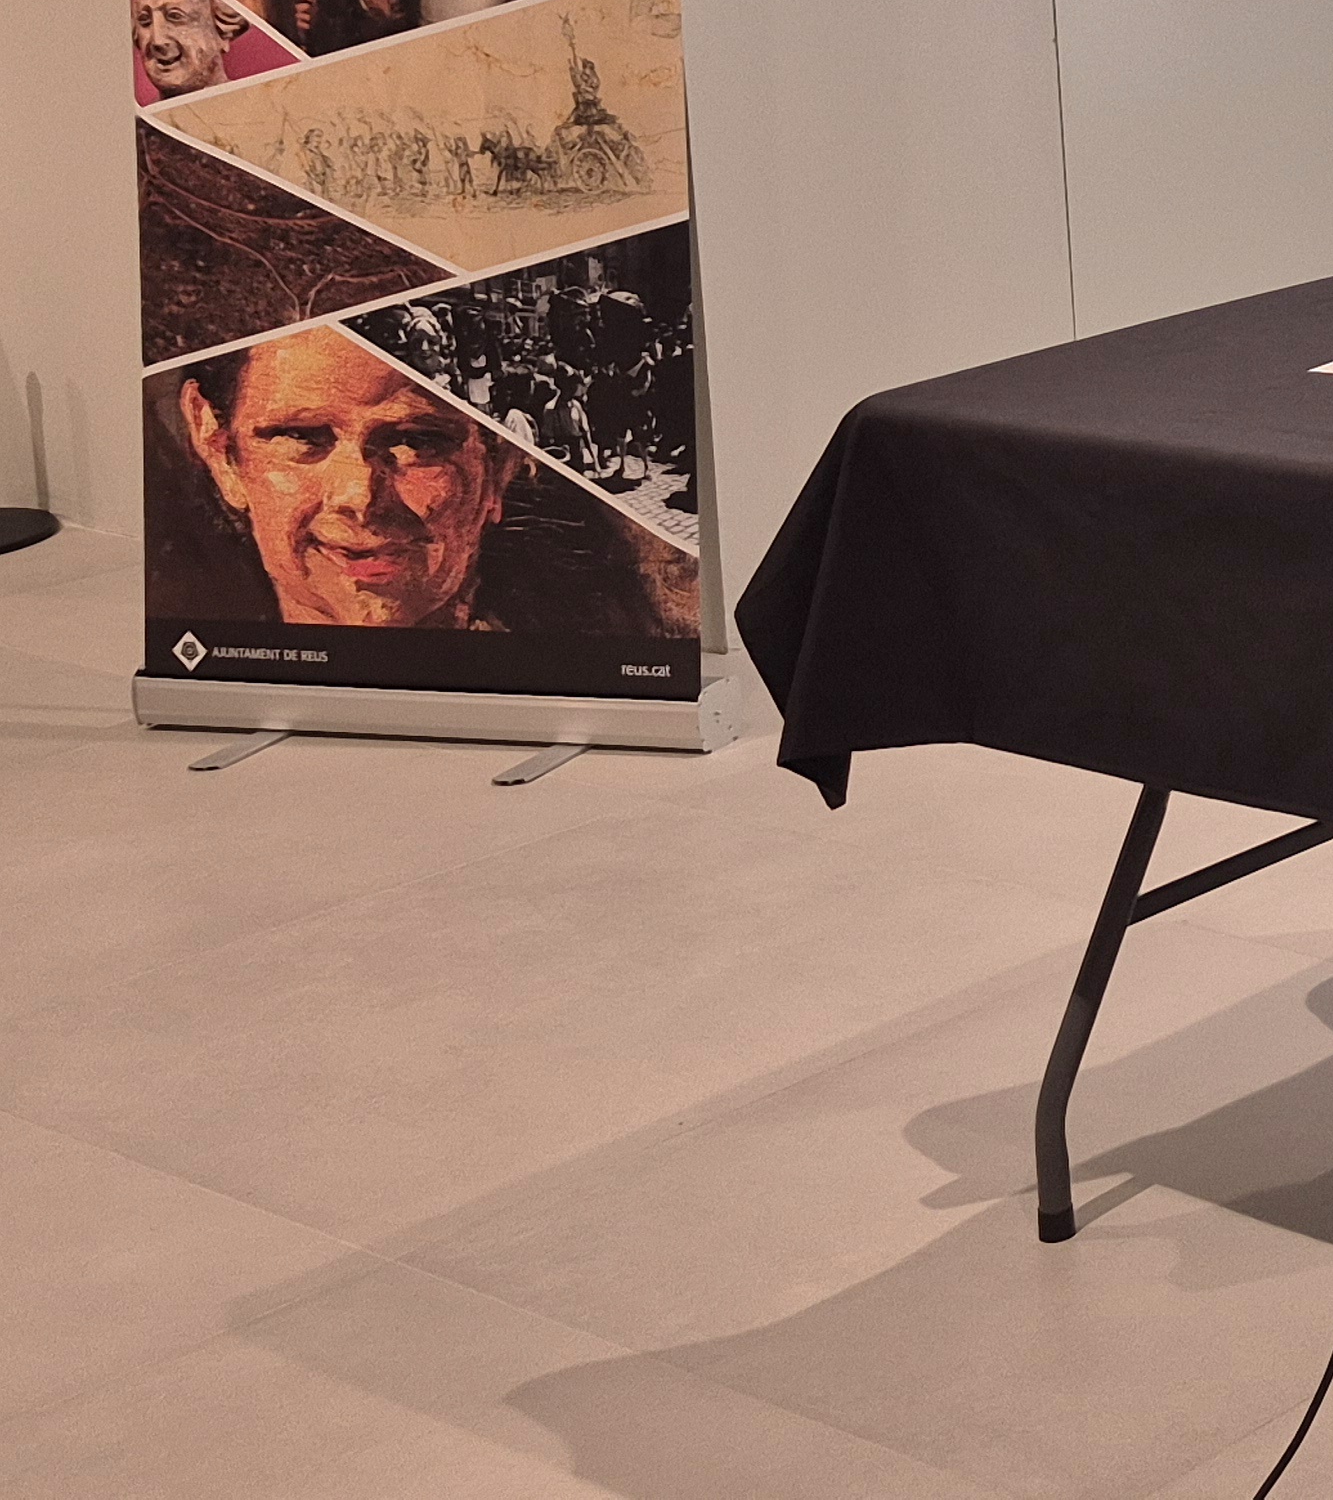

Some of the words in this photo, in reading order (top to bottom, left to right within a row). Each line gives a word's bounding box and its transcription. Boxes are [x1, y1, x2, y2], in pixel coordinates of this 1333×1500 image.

[212, 647, 280, 660] AJUNTAMENT
[284, 649, 298, 660] DE
[301, 650, 328, 662] REUS
[621, 664, 671, 677] reus.cat
